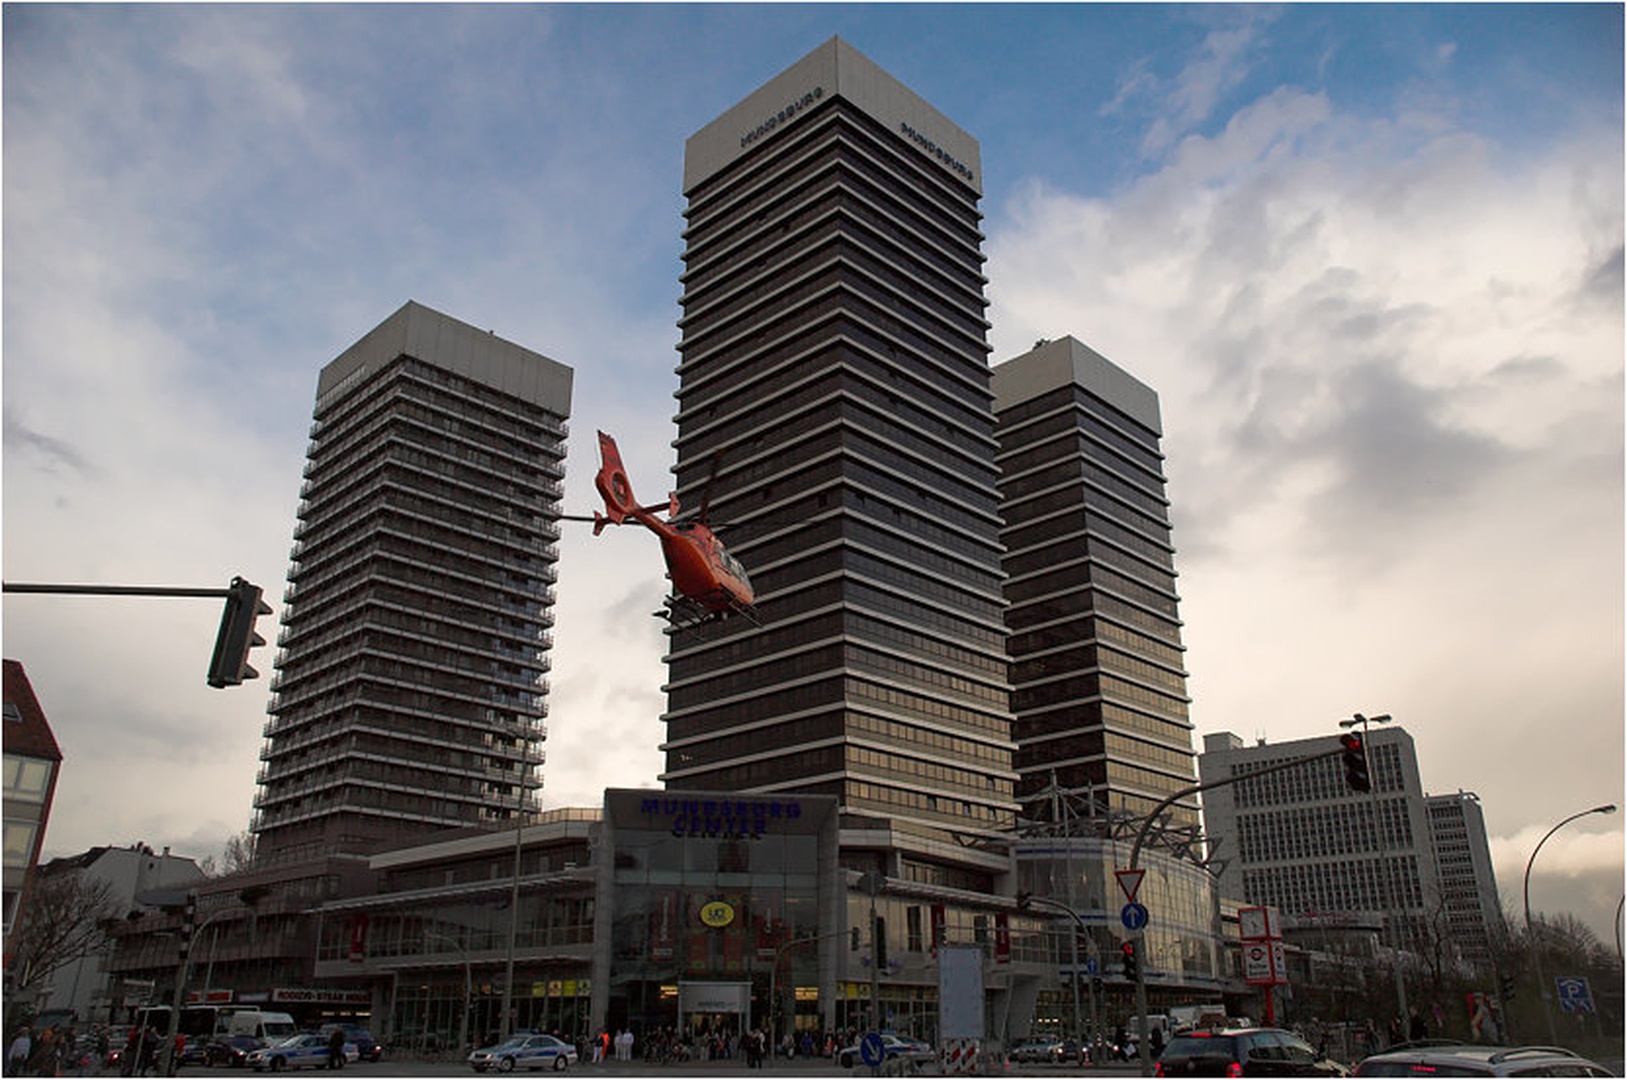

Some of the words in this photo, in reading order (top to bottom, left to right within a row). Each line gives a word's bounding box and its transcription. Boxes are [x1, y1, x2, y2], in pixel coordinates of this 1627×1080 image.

[740, 86, 823, 148] MUNDSBURG
[900, 122, 974, 181] MUNDSBURG
[641, 798, 801, 819] MUNDSBURG
[673, 815, 768, 835] CENTER
